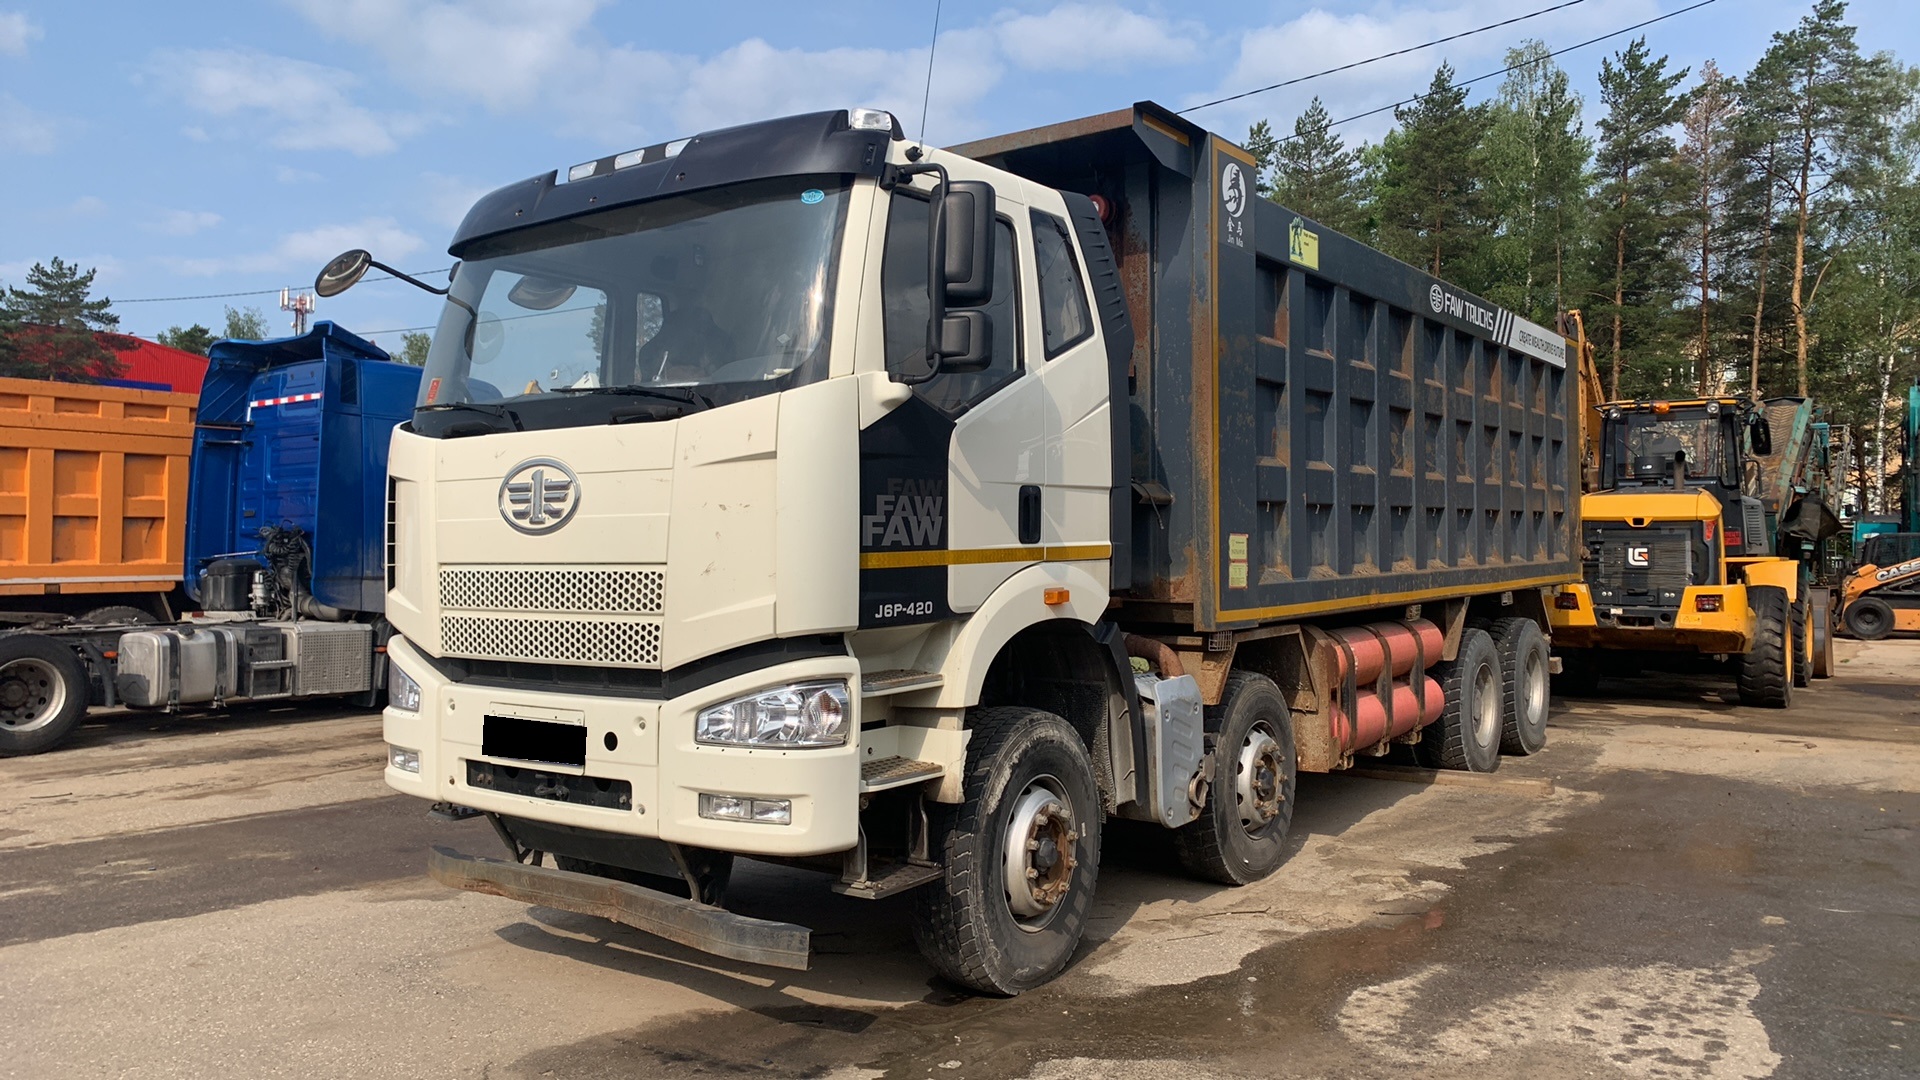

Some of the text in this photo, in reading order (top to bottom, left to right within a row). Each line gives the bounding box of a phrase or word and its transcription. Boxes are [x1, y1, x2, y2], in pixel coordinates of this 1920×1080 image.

[1227, 234, 1244, 248] Jin Ma
[1444, 292, 1494, 331] FAW TRUCKS
[887, 478, 943, 497] FAW
[876, 495, 943, 519] FAW
[862, 515, 943, 546] FAW
[875, 601, 933, 619] J6P-420
